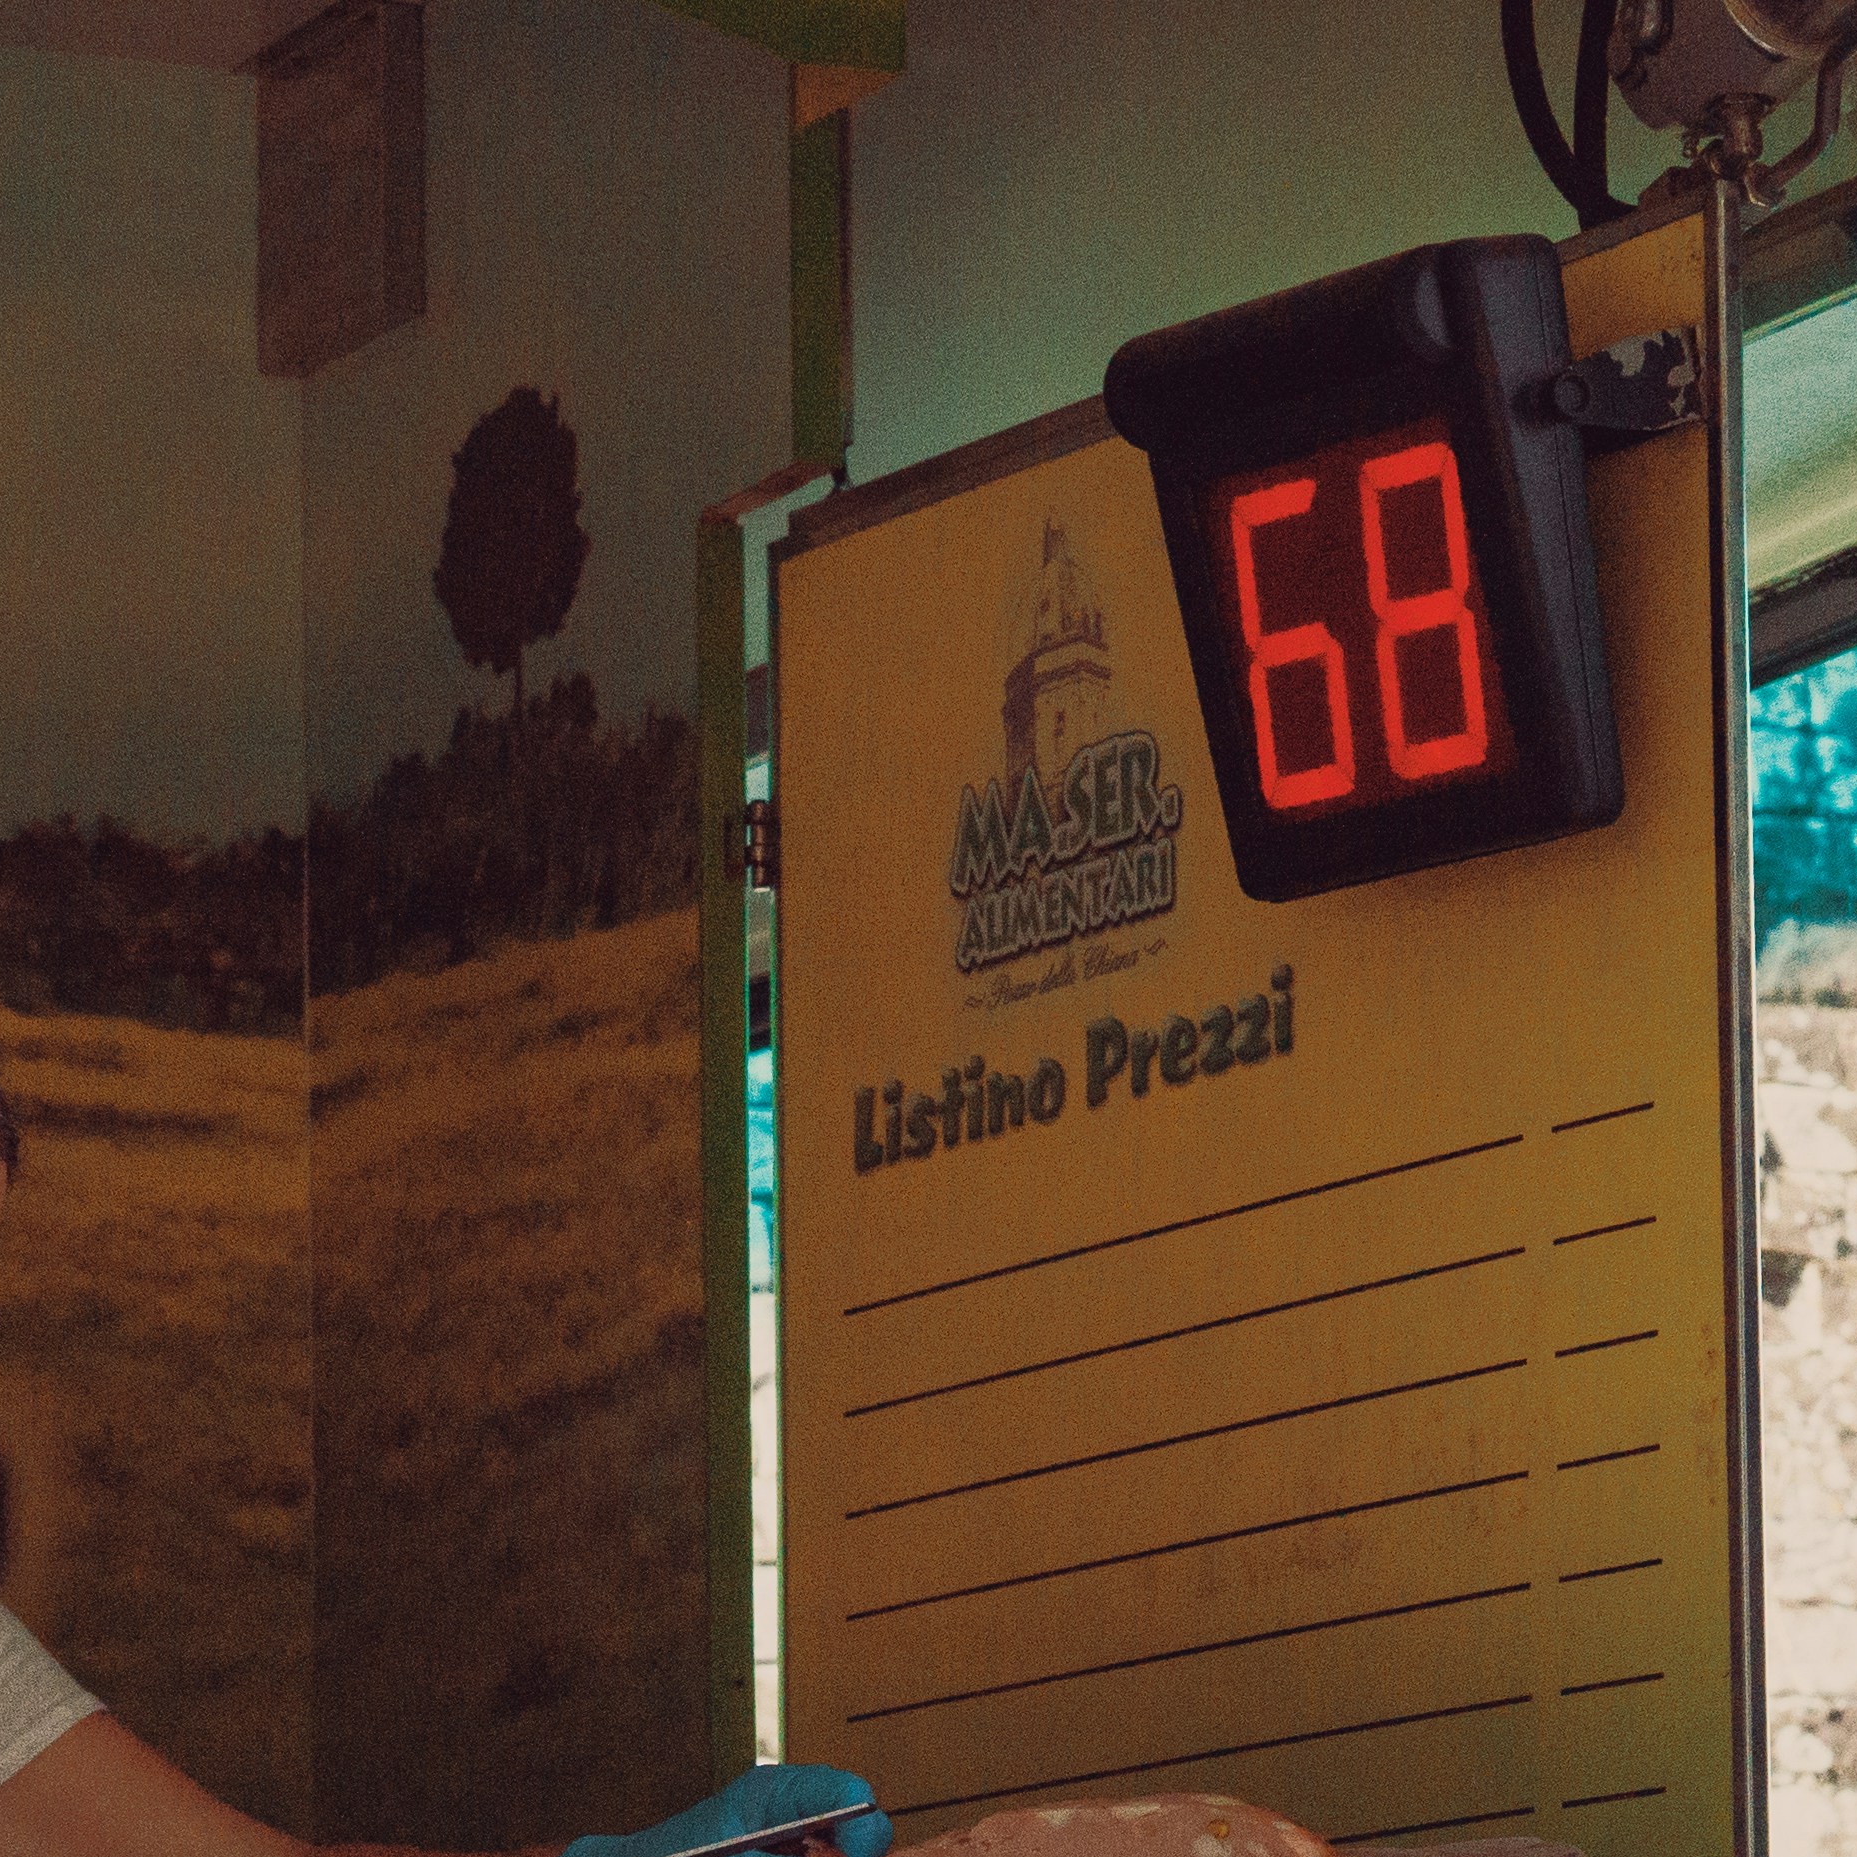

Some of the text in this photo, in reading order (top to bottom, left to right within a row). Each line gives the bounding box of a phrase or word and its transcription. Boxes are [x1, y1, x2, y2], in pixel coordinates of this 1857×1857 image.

[1230, 441, 1488, 810] 68
[956, 837, 1177, 975] ALIMENTARI
[854, 961, 1297, 1176] Listino Prezzi
